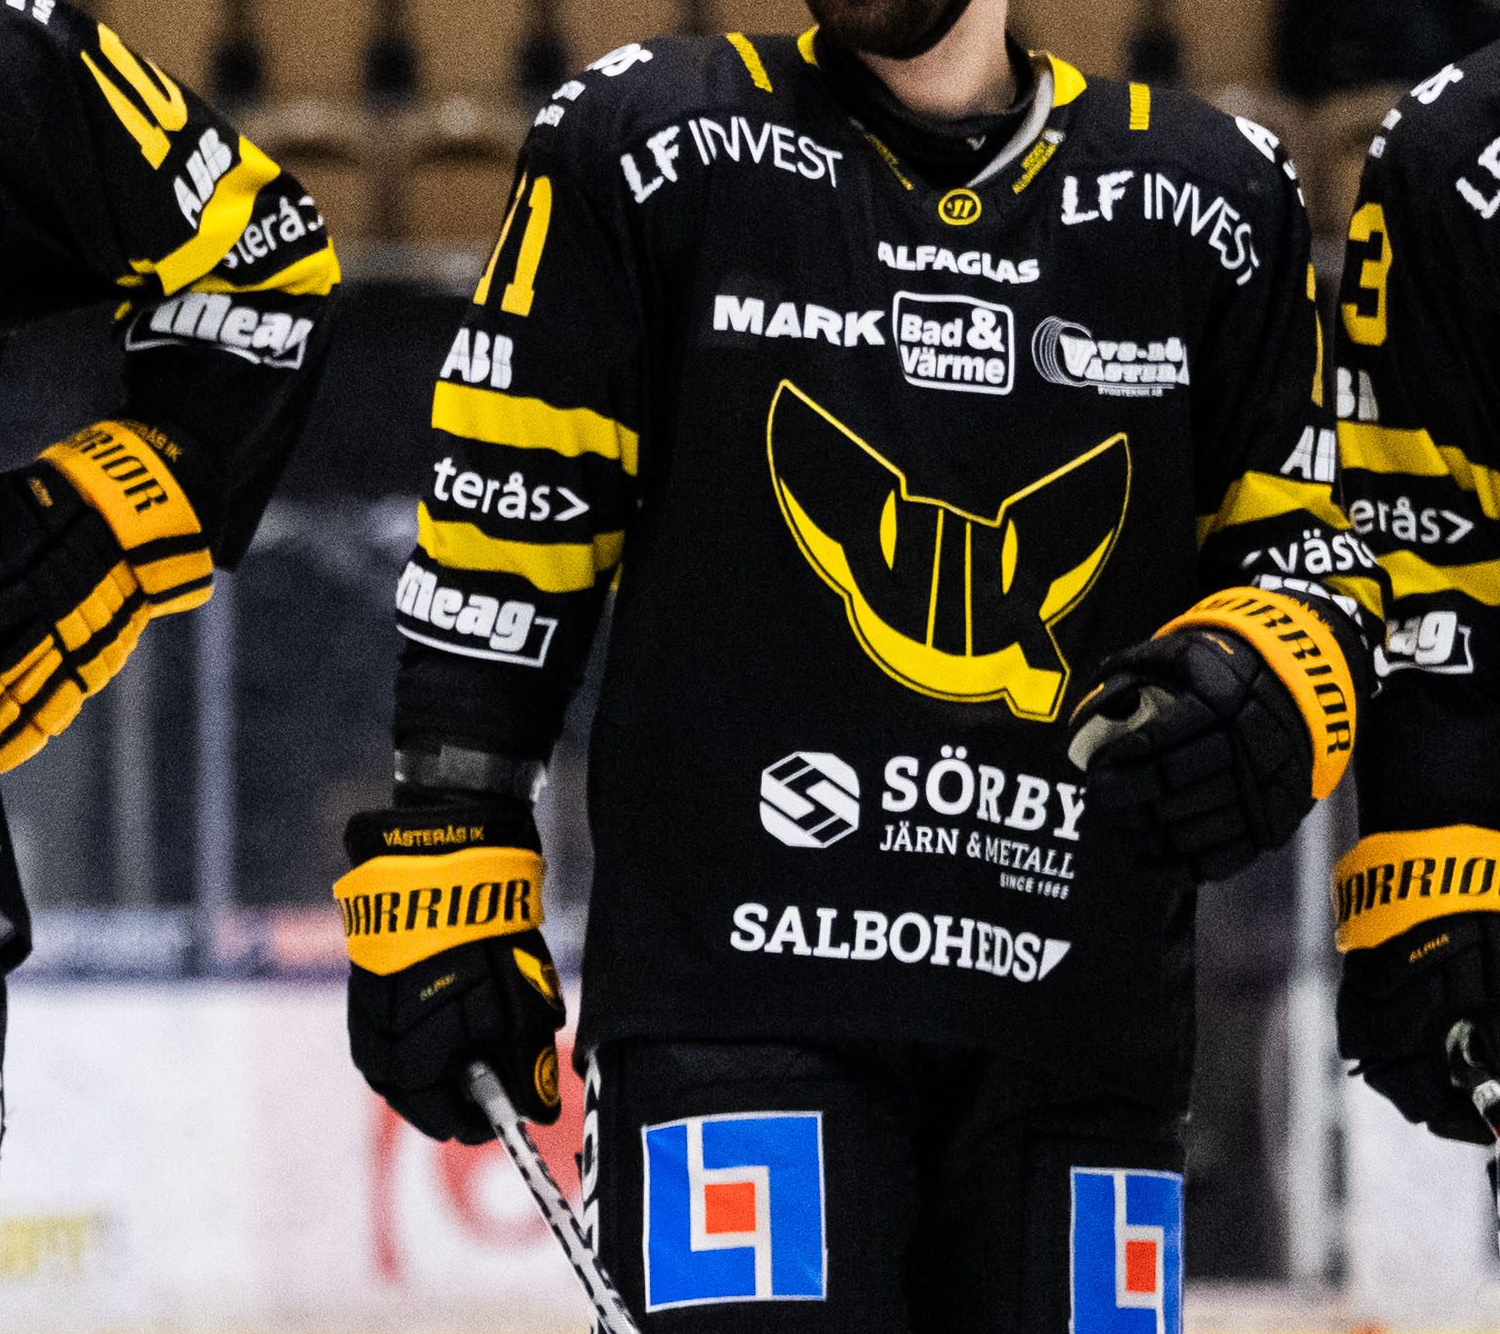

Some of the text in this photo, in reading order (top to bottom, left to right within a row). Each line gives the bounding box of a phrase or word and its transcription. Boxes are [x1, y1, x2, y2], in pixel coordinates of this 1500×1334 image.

[620, 124, 684, 204] LF
[688, 114, 844, 188] INVEST
[1060, 169, 1137, 227] LF
[877, 240, 1041, 285] ALFAGLAS
[712, 293, 887, 348] MARK
[900, 307, 1006, 353] Bad &
[900, 344, 1006, 385] Värme
[881, 744, 1088, 842] SÖRBY
[879, 821, 1076, 880] JÄRN & METALL
[1000, 872, 1035, 894] SINCE
[1337, 857, 1500, 922] WARRIO
[730, 902, 1043, 983] SALBOHEDS
